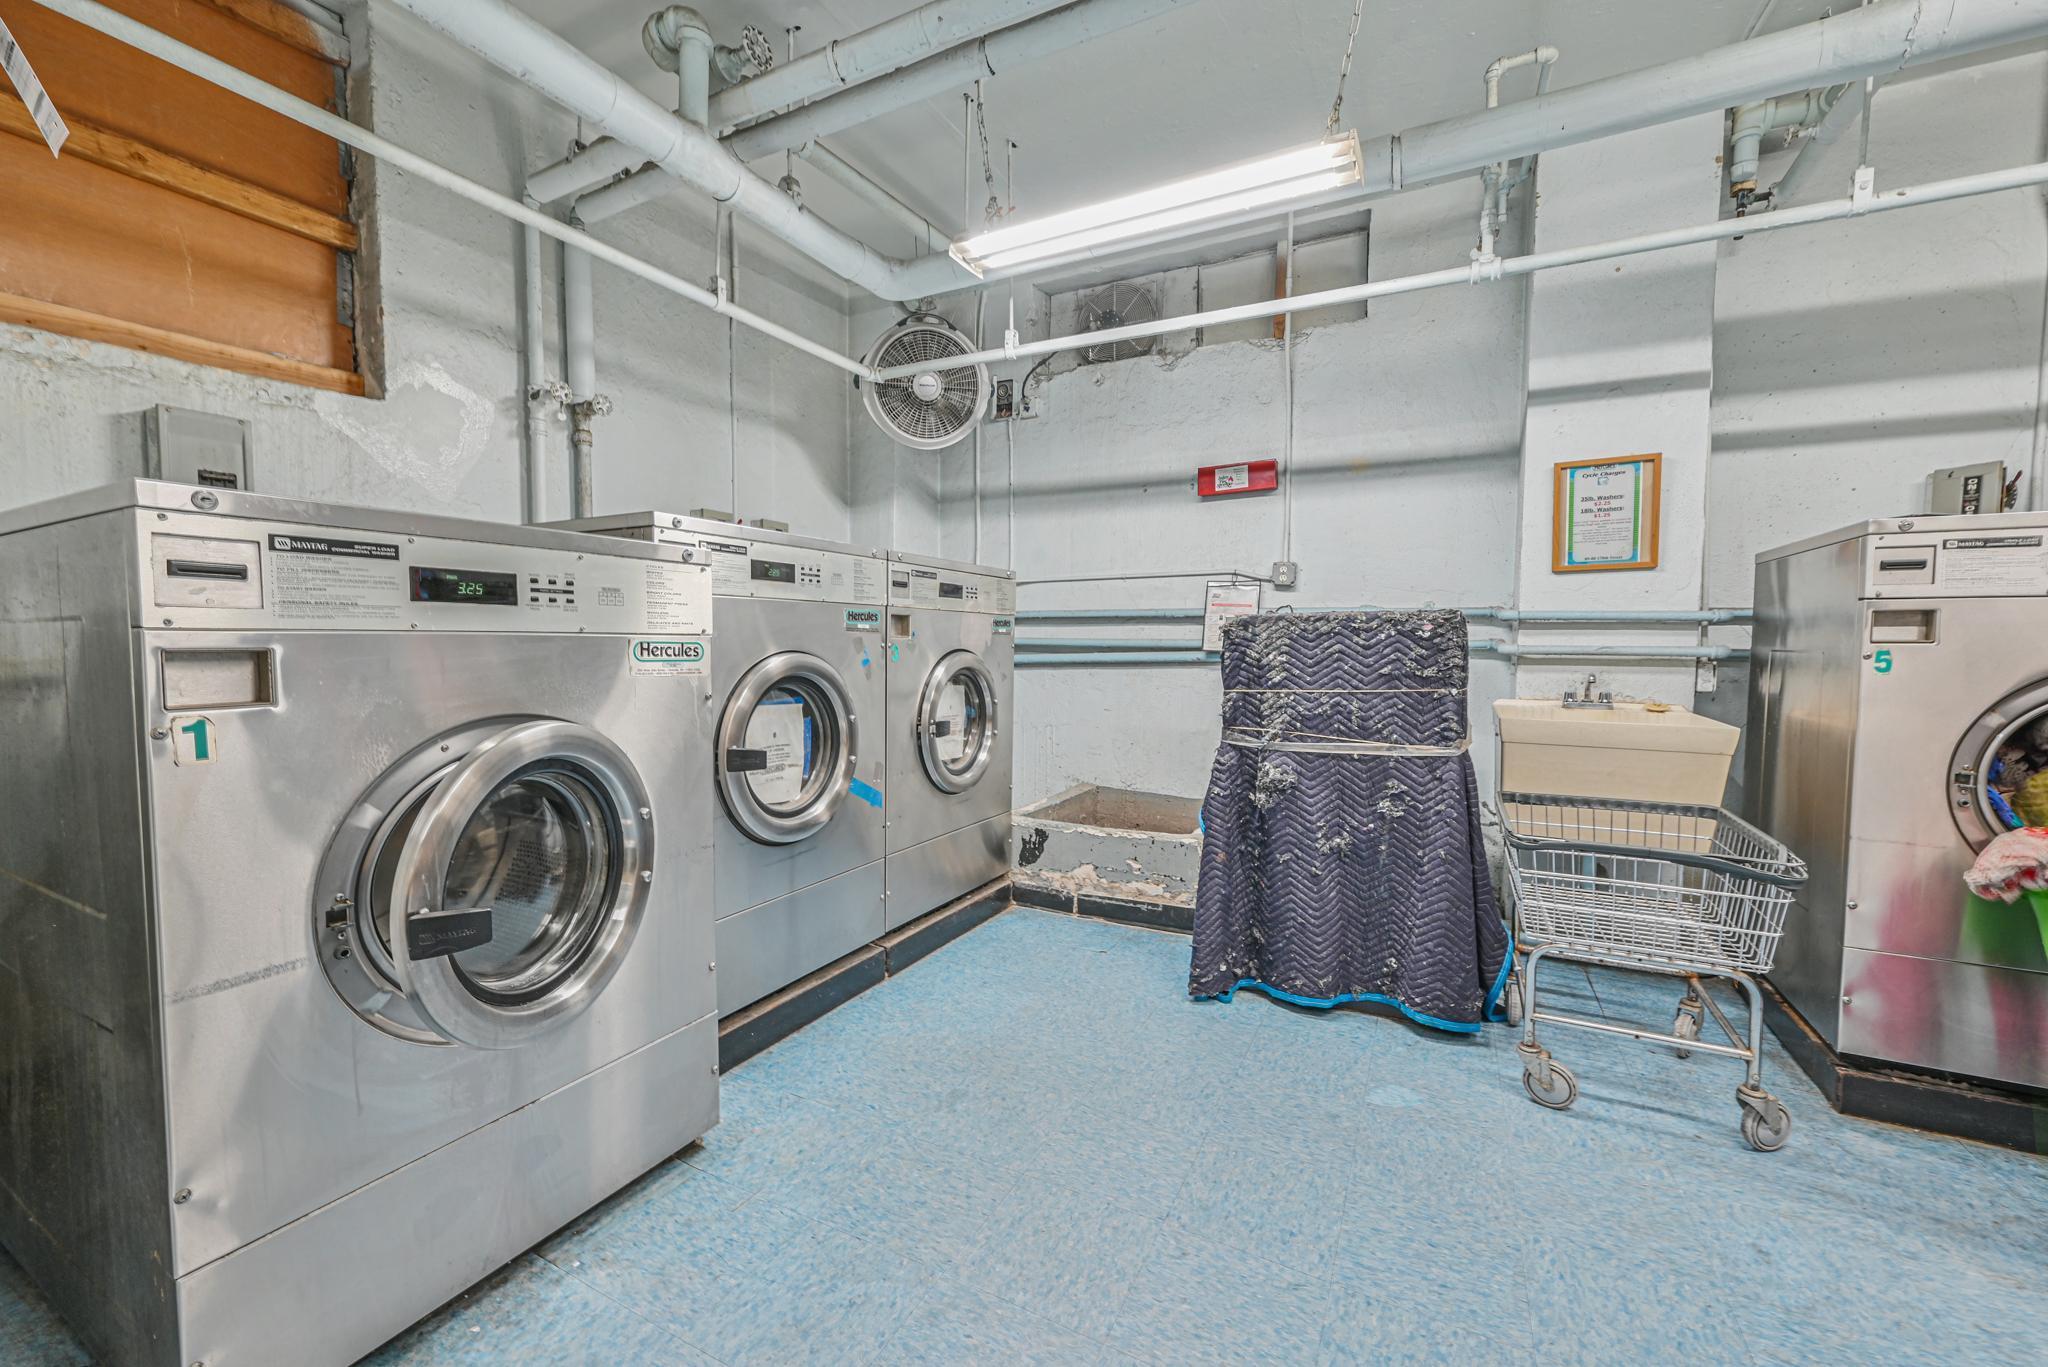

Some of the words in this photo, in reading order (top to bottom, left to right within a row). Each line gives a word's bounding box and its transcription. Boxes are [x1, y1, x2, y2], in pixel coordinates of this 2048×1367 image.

[291, 540, 329, 551] MAYTAG
[847, 610, 879, 622] Hercules
[992, 618, 1011, 628] Hercules
[639, 641, 700, 658] Hercules
[1873, 650, 1893, 673] 5
[181, 719, 209, 761] 1
